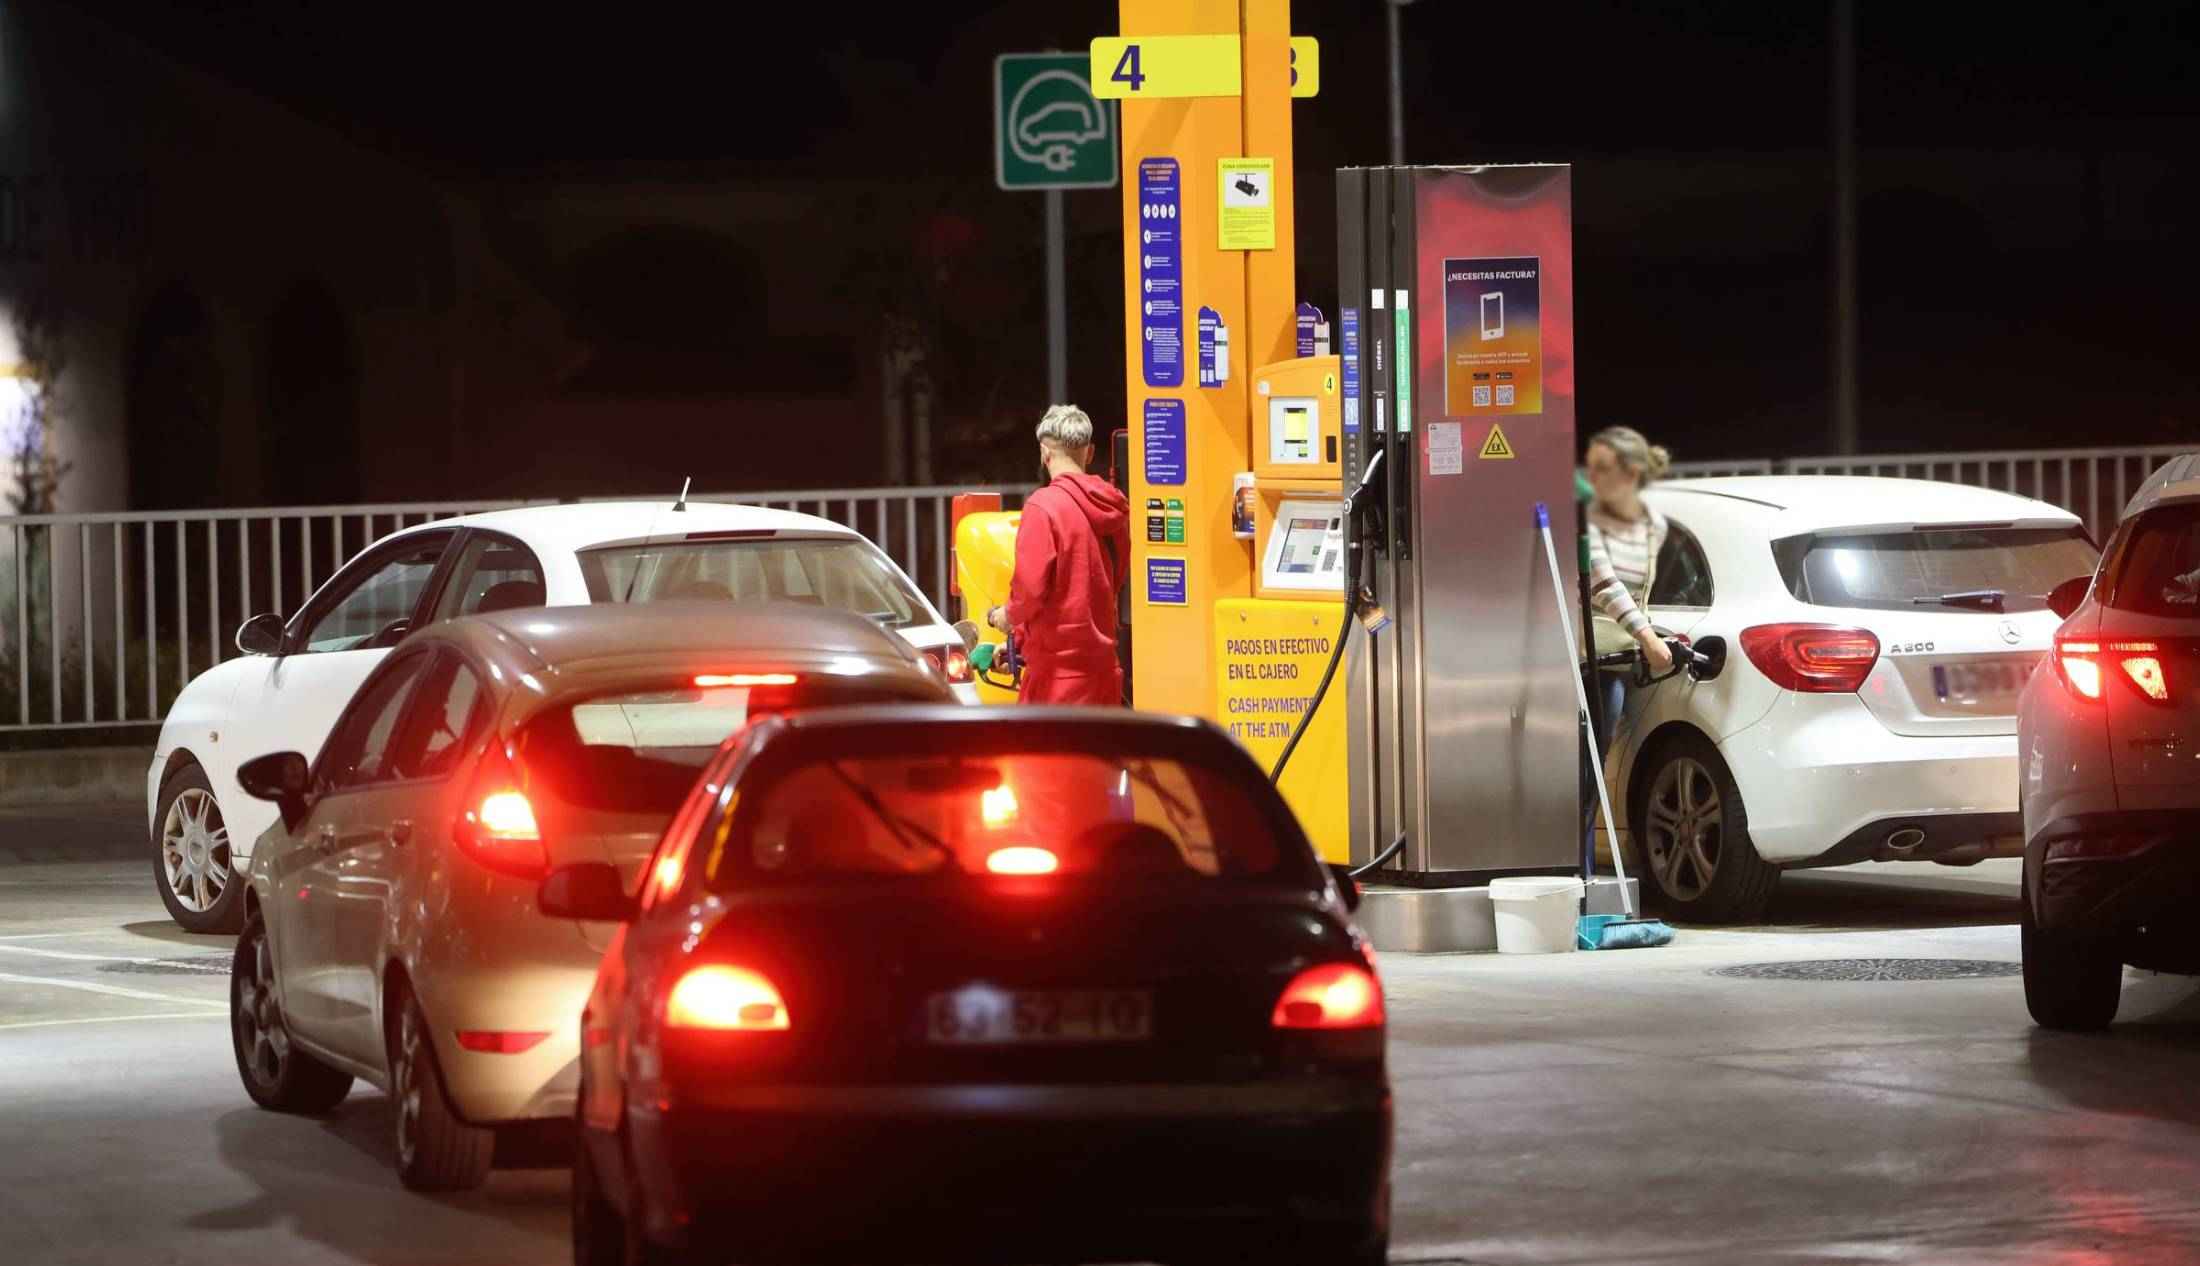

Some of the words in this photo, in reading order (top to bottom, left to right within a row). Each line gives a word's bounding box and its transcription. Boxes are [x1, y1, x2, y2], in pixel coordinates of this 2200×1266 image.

[1111, 45, 1145, 91] 4
[1447, 271, 1494, 282] ¿NECESITAS
[1495, 270, 1536, 280] FACTURA?
[1326, 376, 1332, 391] 4
[1227, 640, 1262, 654] PAGOS
[1264, 640, 1277, 655] EN
[1280, 638, 1329, 655] EFECTIVO
[1891, 644, 1902, 654] A
[1229, 664, 1243, 679] EN
[1246, 664, 1257, 679] EL
[1259, 664, 1298, 679] CAJERO
[1229, 698, 1259, 713] CASH
[1246, 723, 1266, 738] THE
[1268, 723, 1290, 738] ATM
